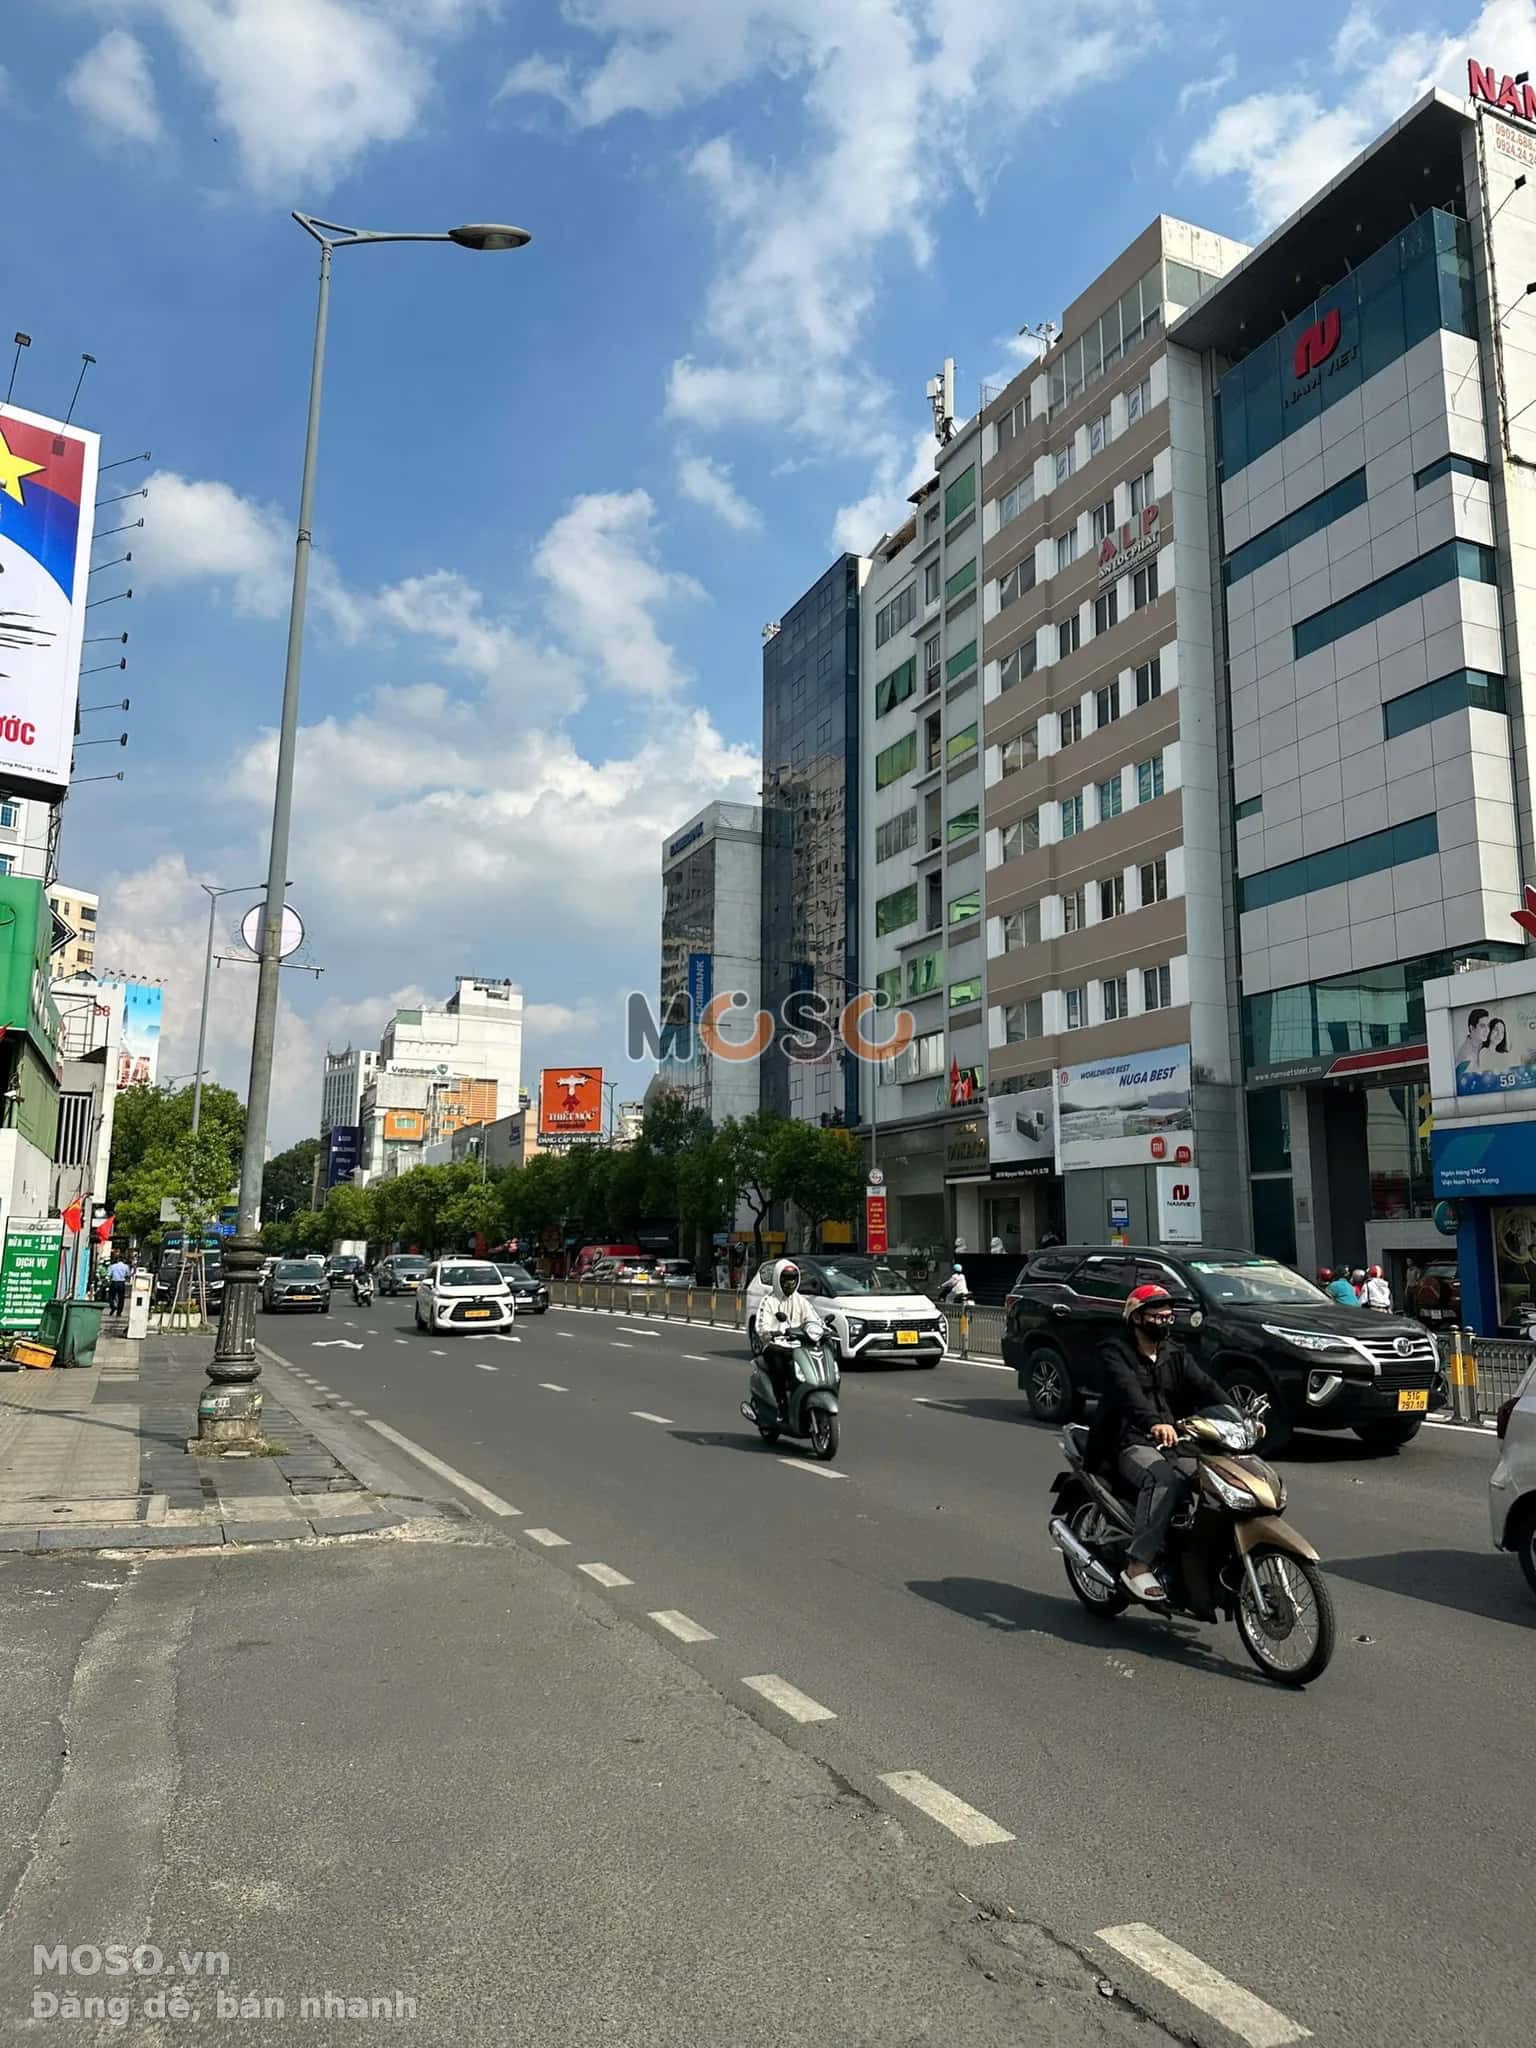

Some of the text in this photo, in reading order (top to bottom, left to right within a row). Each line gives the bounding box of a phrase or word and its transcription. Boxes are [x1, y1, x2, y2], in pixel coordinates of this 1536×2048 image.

[1080, 1063, 1131, 1080] WORLDWIDE BEST
[1119, 1066, 1177, 1087] NUGA BEST
